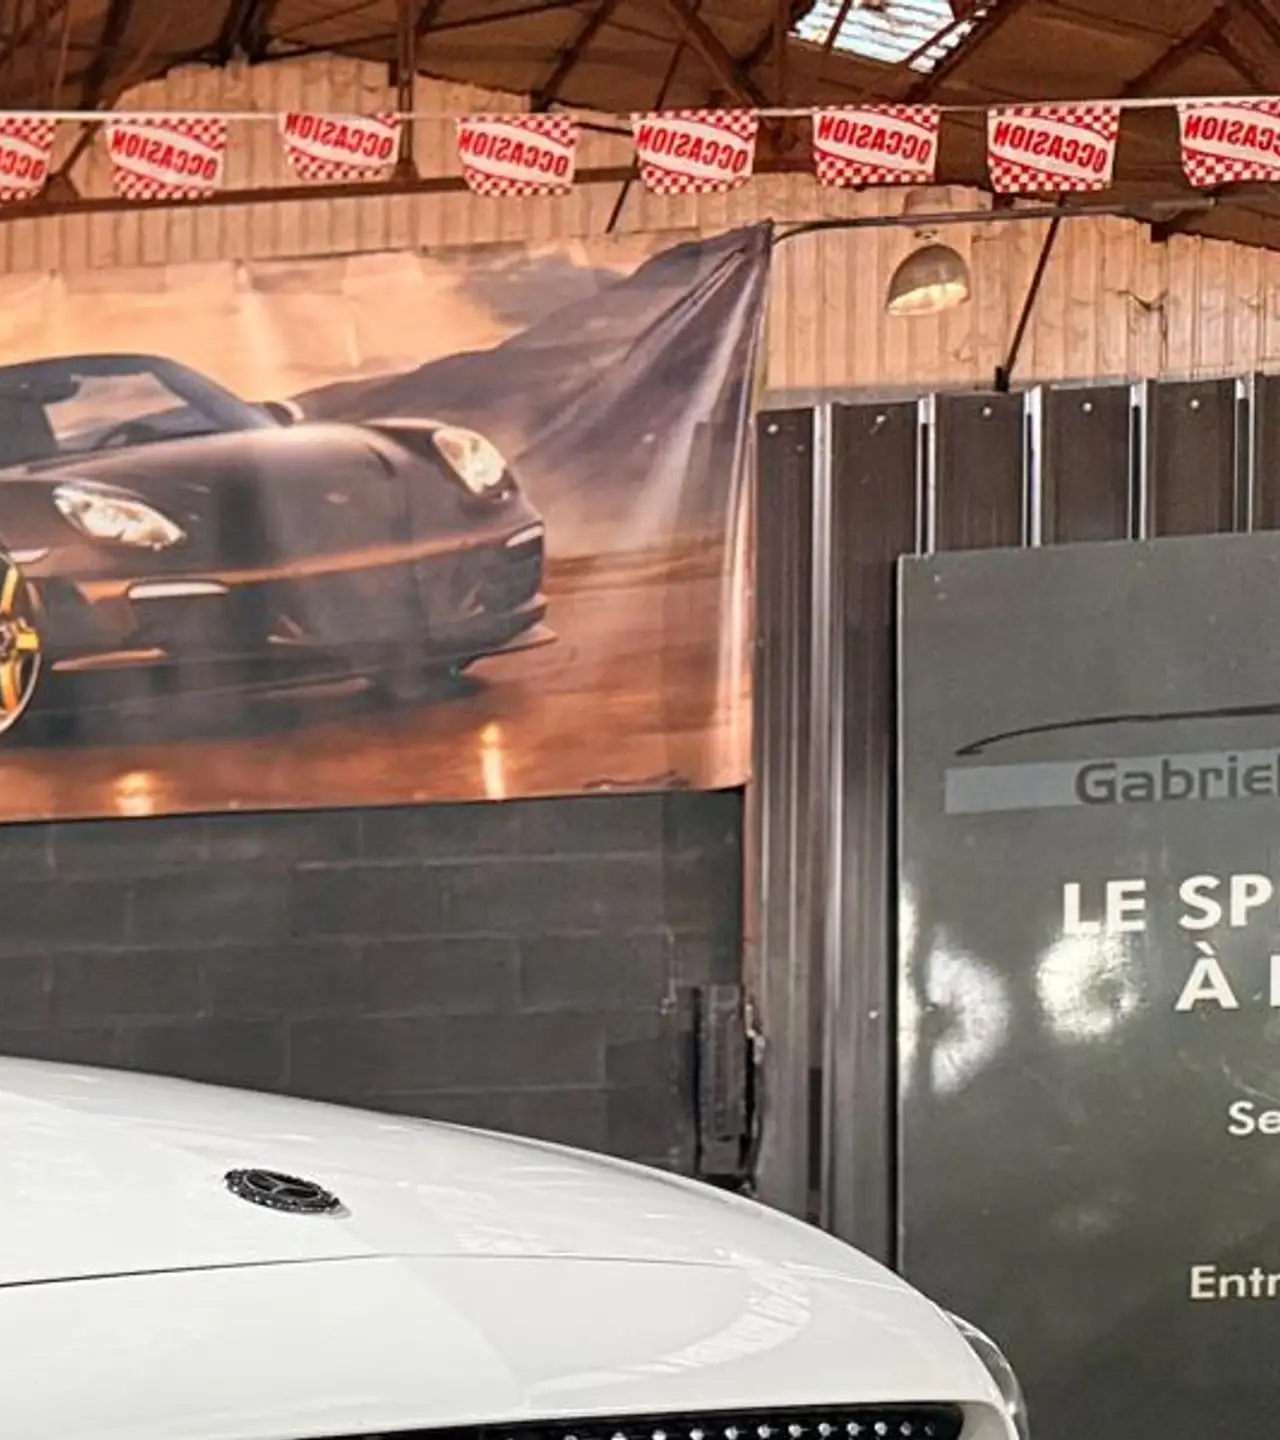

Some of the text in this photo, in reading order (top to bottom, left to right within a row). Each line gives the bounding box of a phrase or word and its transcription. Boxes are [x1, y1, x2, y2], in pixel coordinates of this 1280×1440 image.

[1063, 873, 1273, 935] LE SP
[1174, 940, 1240, 1012] À
[1228, 1100, 1280, 1136] Se
